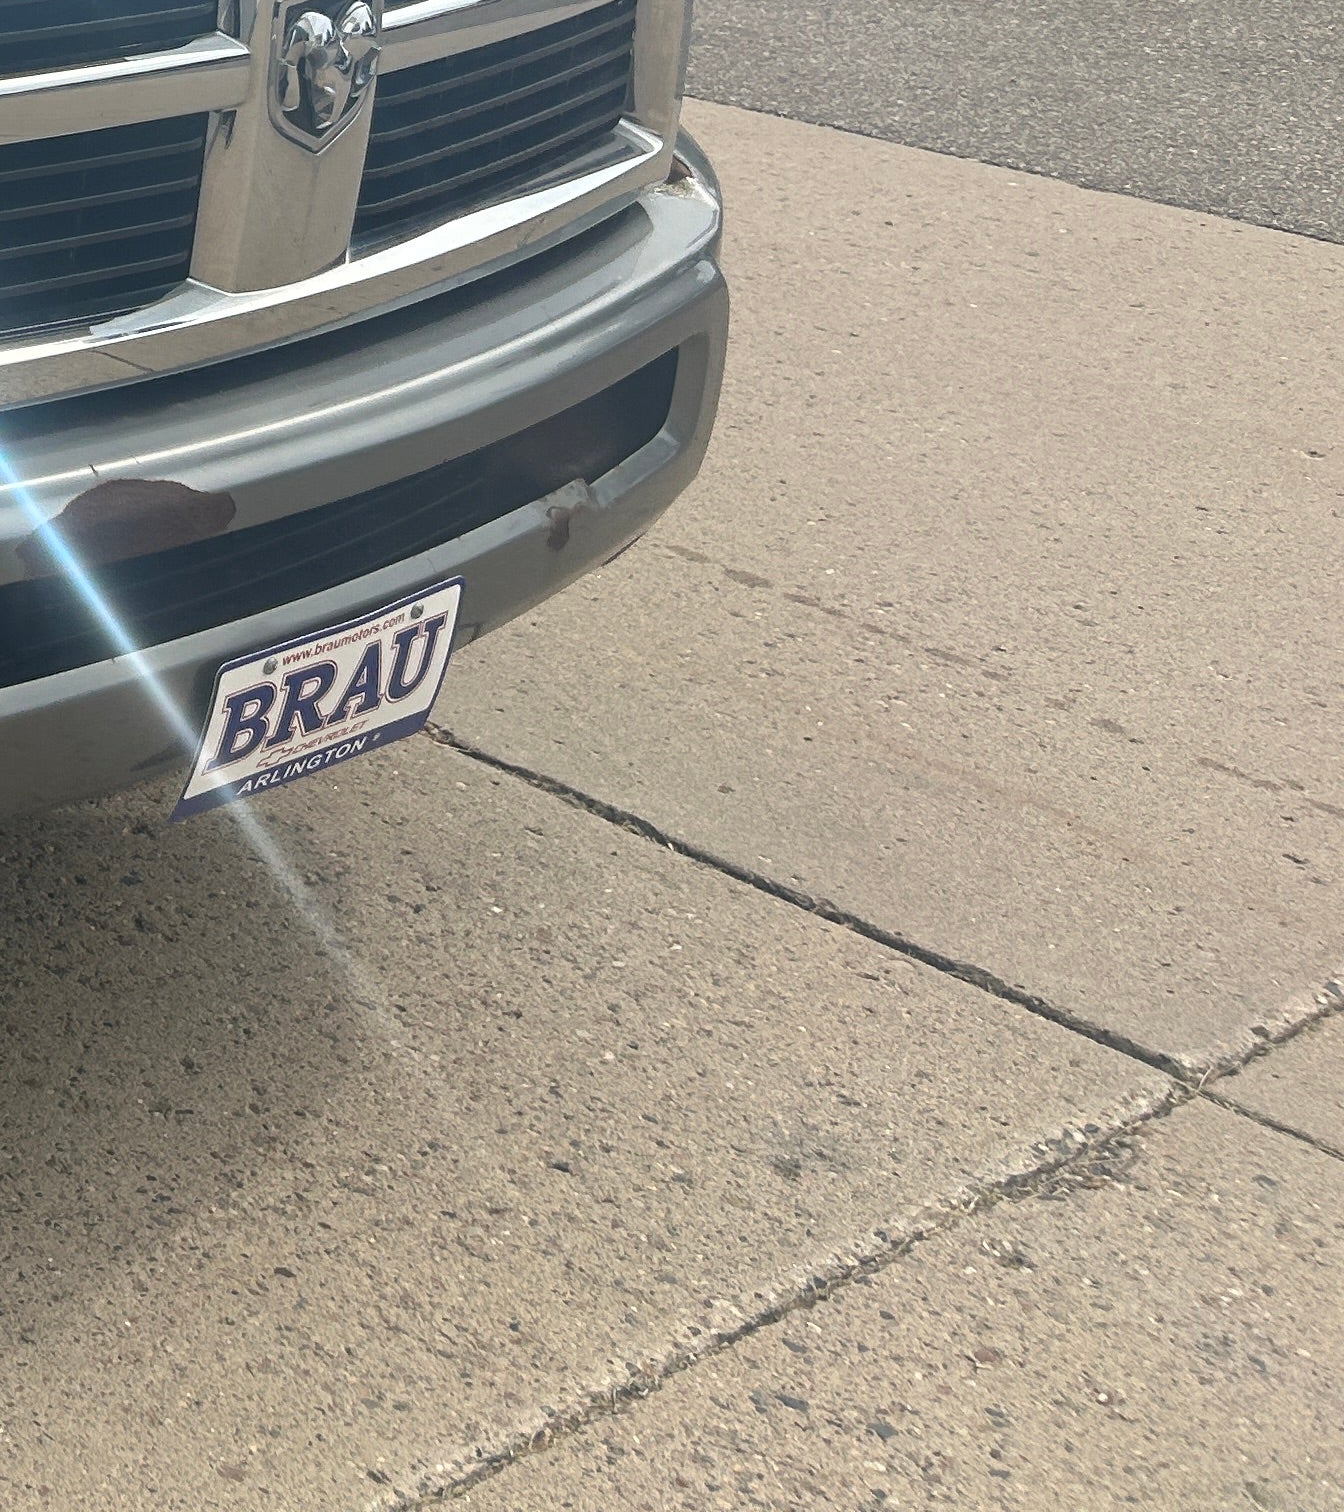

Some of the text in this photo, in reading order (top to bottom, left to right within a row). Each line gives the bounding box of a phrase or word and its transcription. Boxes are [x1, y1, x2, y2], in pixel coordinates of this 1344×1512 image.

[282, 613, 405, 666] www.braumotors.com
[201, 610, 449, 776] BRAU
[236, 736, 367, 795] ARLINGTON
